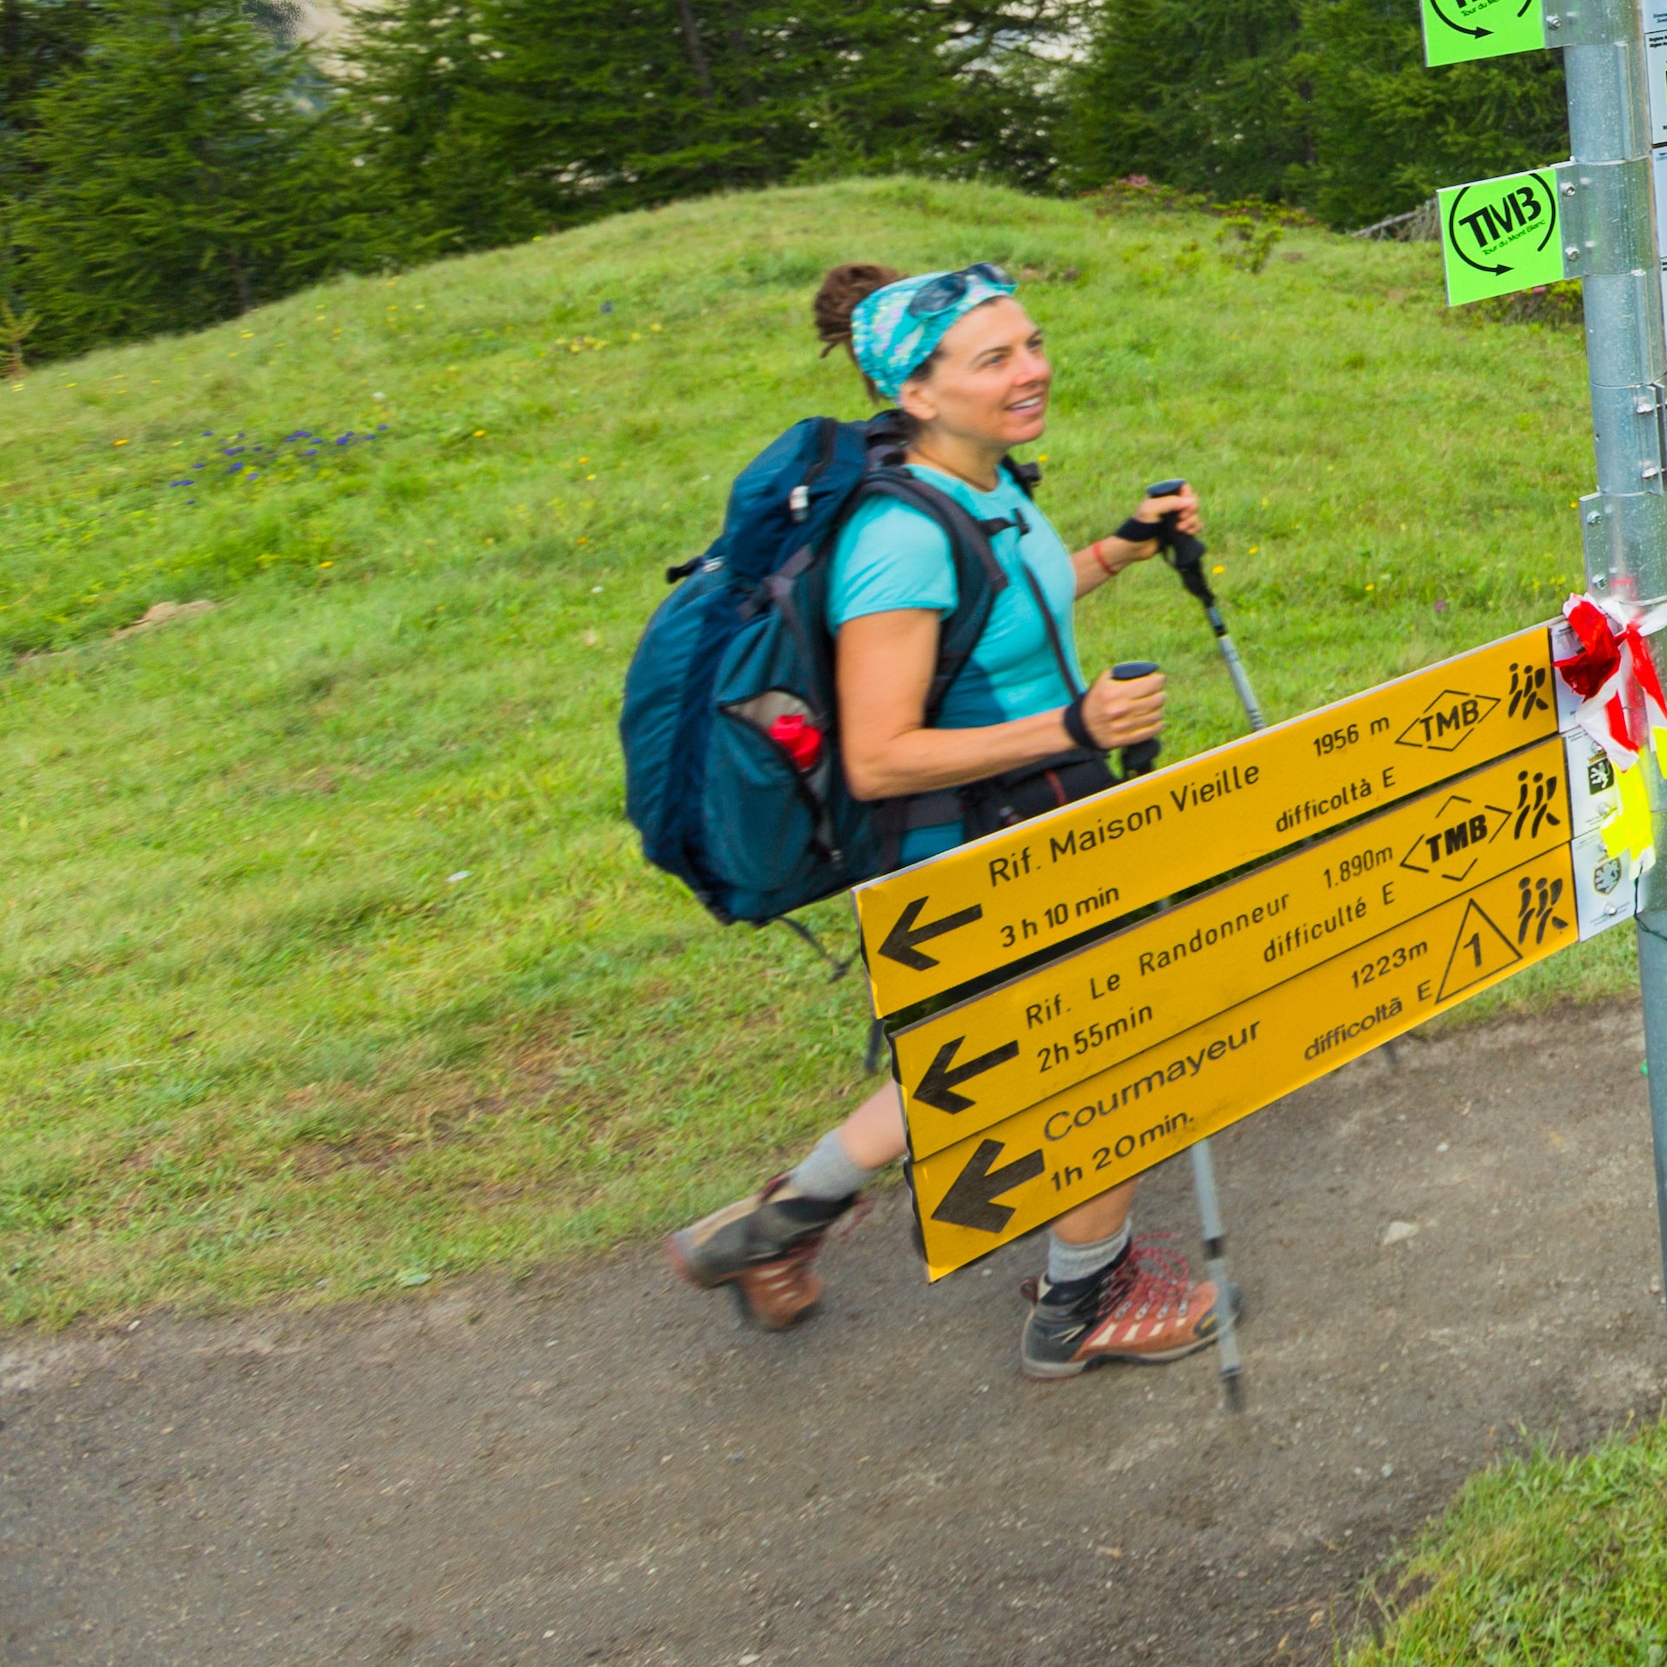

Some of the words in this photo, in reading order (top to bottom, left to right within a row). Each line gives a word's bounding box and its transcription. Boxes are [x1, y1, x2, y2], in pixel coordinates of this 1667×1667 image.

[1458, 186, 1541, 248] TMB
[1313, 724, 1359, 757] 1956
[1370, 716, 1391, 736] m
[1419, 698, 1479, 742] TMB
[988, 846, 1042, 887] Rif.
[1050, 803, 1162, 862] Maison
[1170, 765, 1260, 812] Vieille
[1273, 778, 1373, 833] difficoltà
[1382, 766, 1396, 788] E
[1425, 814, 1488, 864] TMB
[1323, 846, 1394, 890] 1.890m
[1263, 897, 1367, 964] difficulté
[1382, 881, 1396, 907] E
[1025, 993, 1072, 1030] Rif.
[1089, 972, 1121, 1001] Le
[1138, 893, 1290, 977] Randonneur
[1350, 940, 1429, 989] 1223m
[1463, 933, 1482, 969] 1
[1304, 997, 1403, 1061] difficoltà
[1417, 979, 1433, 1002] E
[1044, 1021, 1261, 1142] Courmayeur
[1050, 1166, 1084, 1192] 1h
